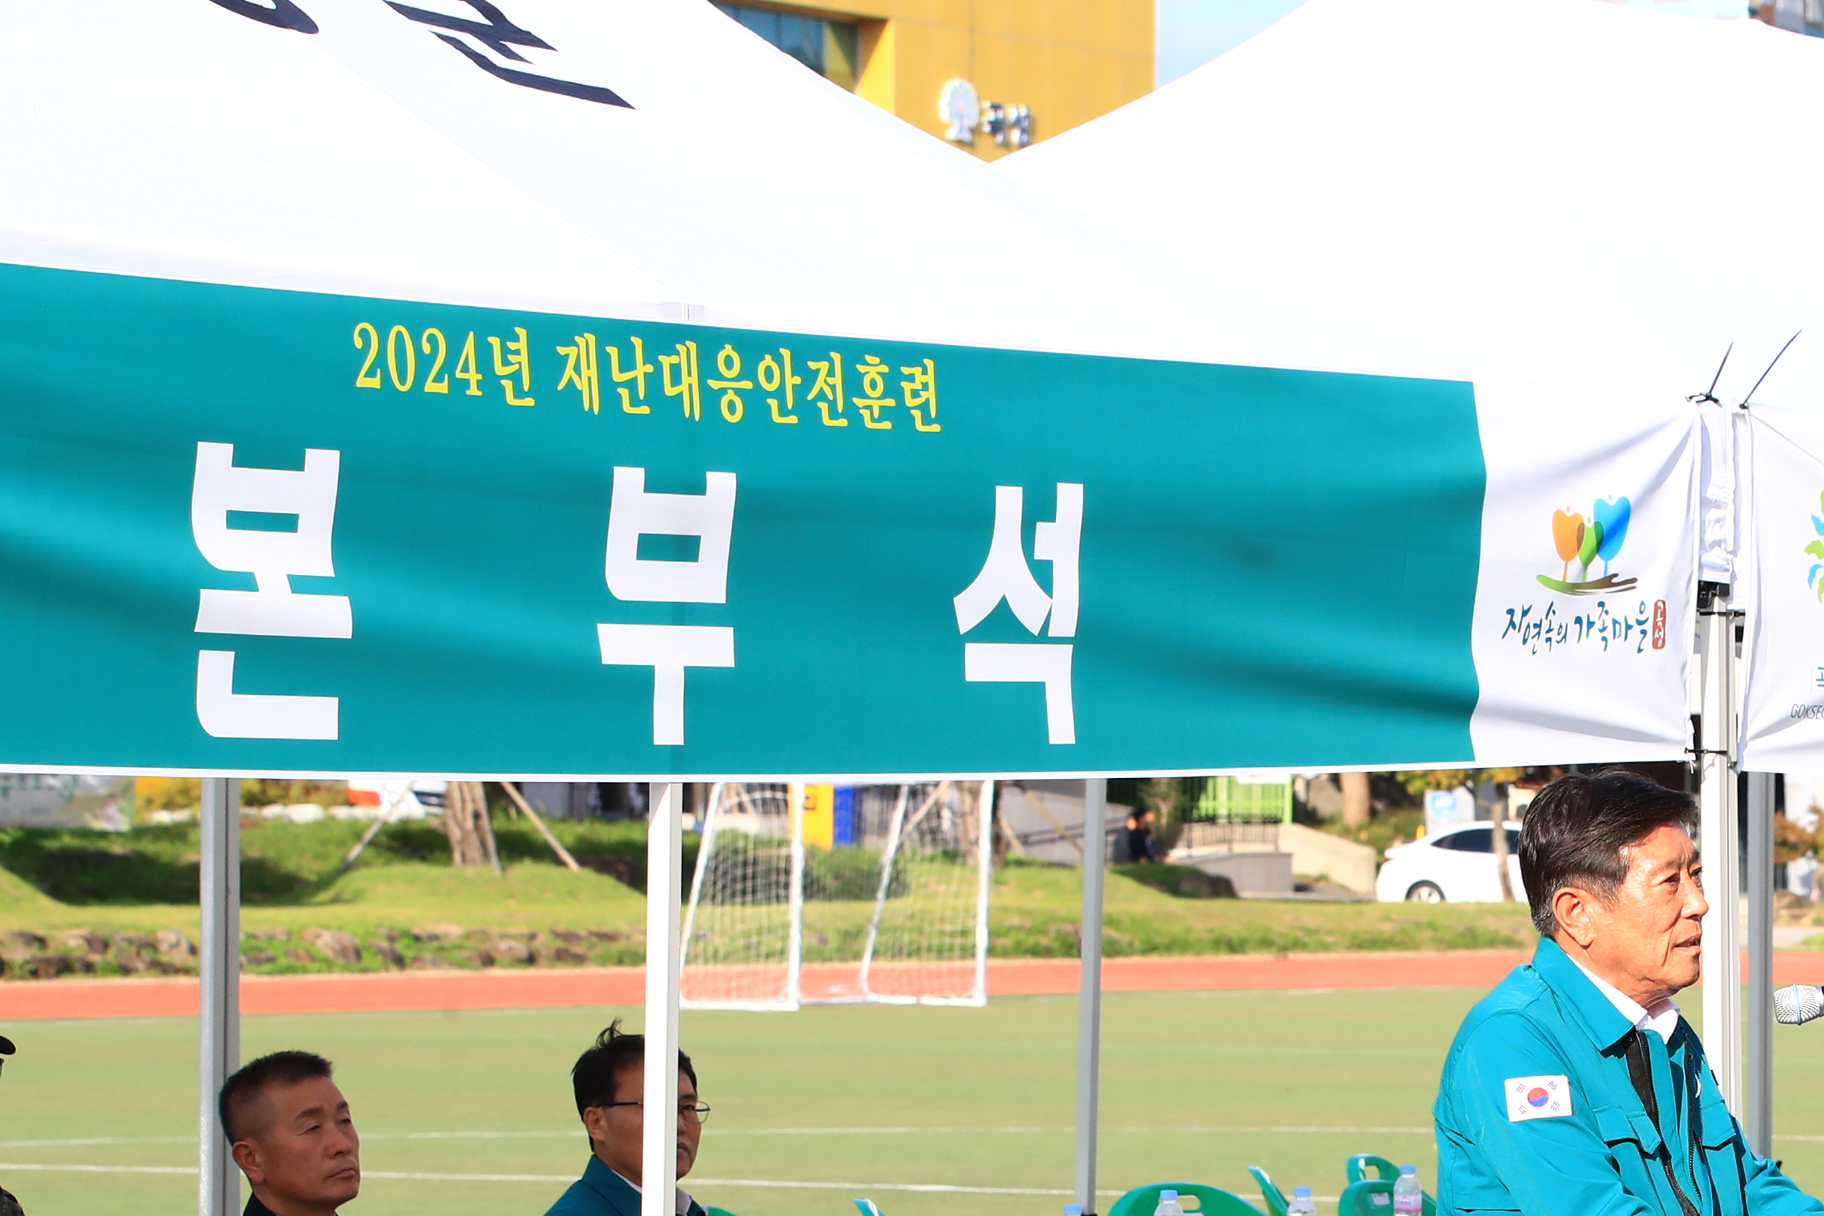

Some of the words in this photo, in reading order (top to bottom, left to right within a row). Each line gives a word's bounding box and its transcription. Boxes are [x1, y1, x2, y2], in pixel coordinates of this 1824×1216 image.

[353, 322, 536, 408] 2024년
[555, 331, 943, 435] 재난대응안전훈련
[1501, 601, 1568, 655] 자연속의
[1574, 600, 1650, 654] 가족마을
